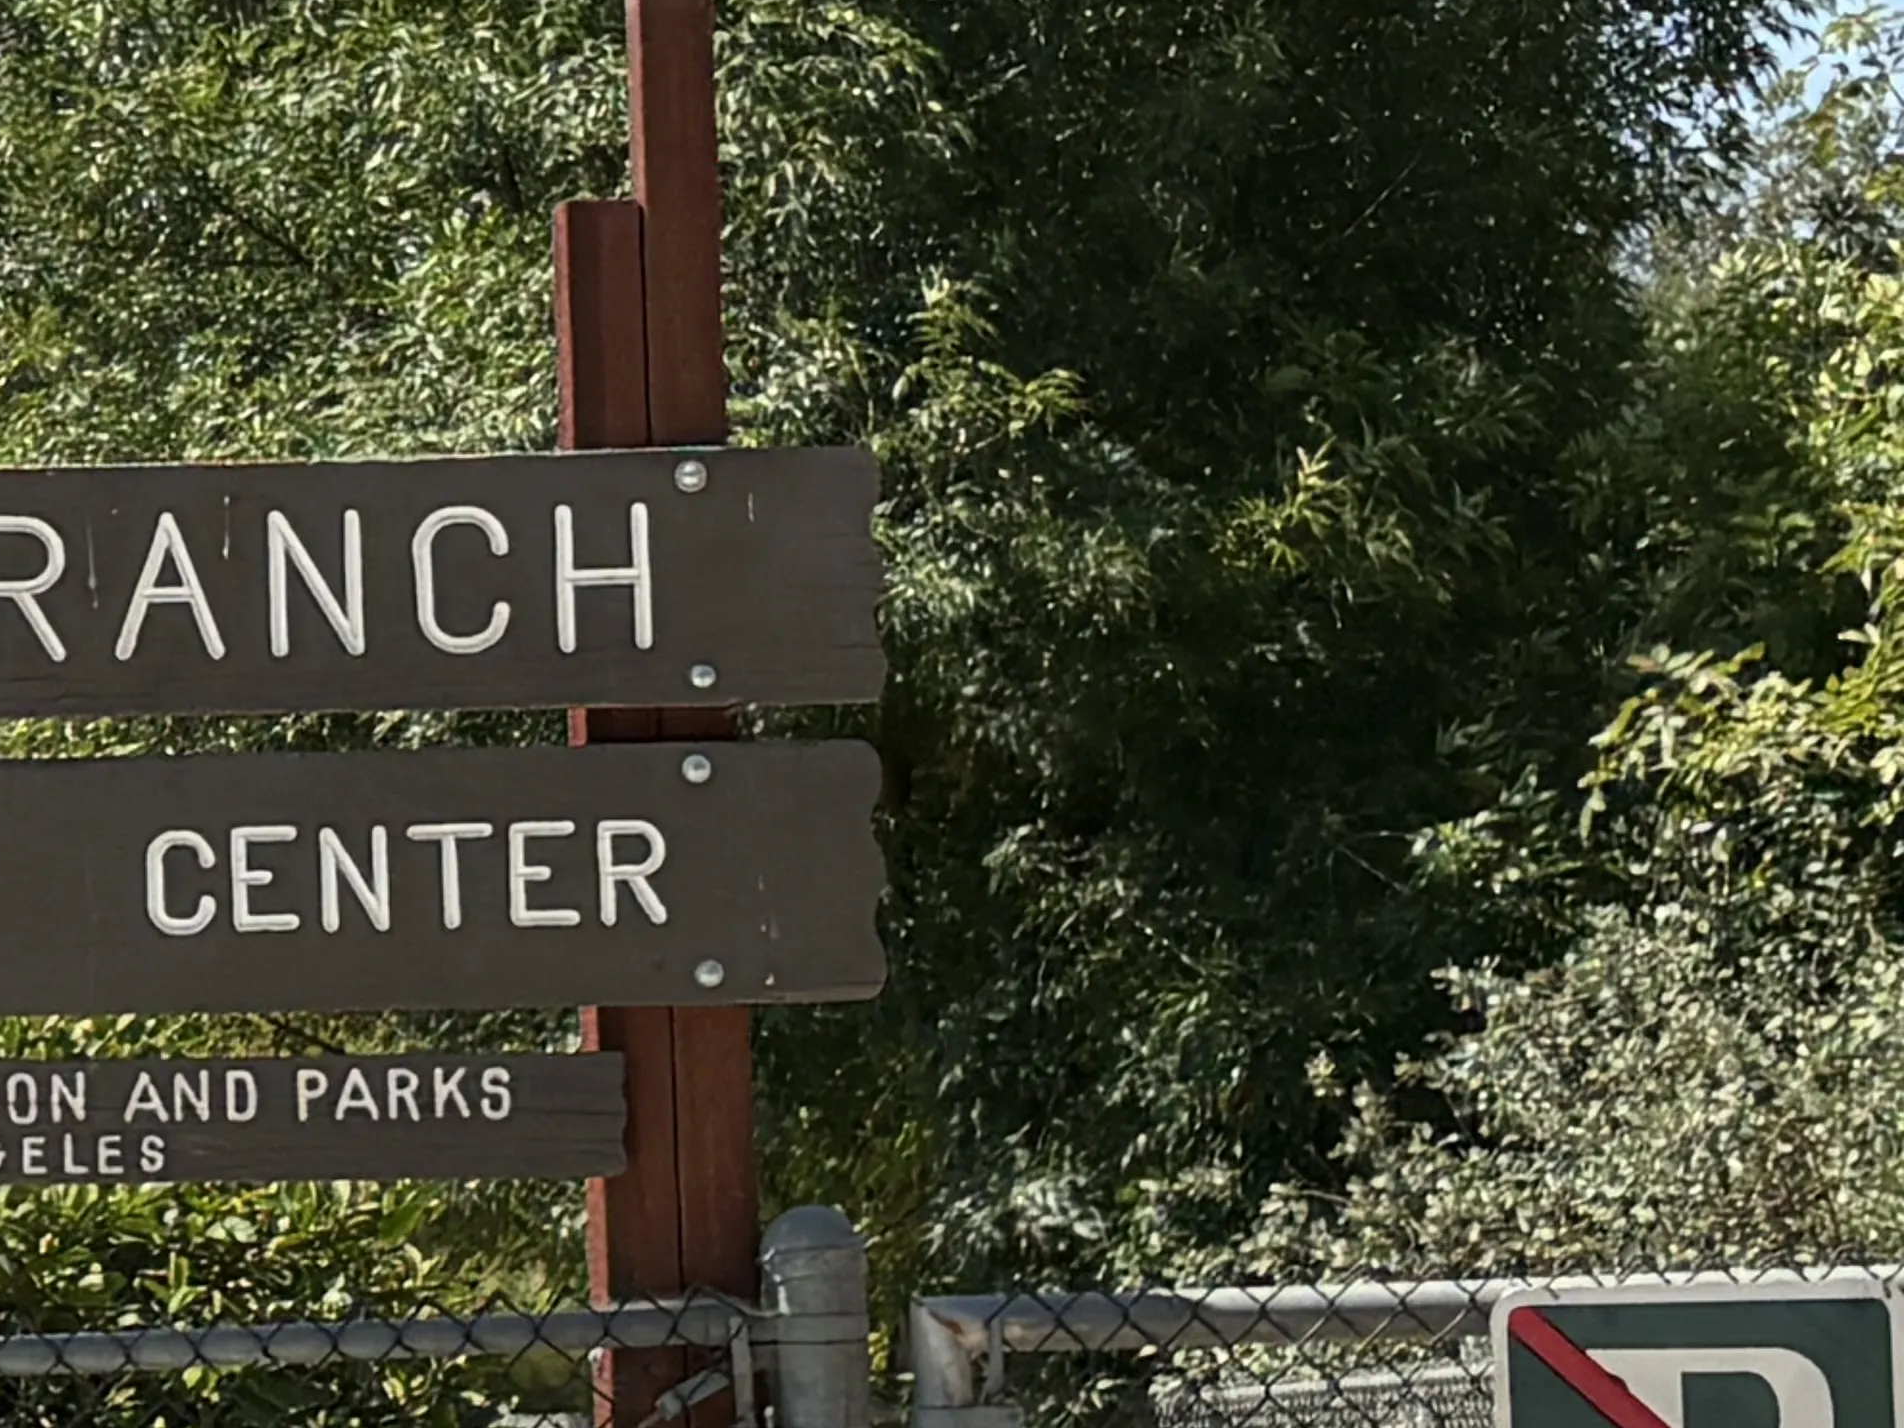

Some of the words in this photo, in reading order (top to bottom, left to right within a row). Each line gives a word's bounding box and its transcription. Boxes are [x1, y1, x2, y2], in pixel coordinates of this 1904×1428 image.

[145, 819, 668, 935] CENTER
[123, 1069, 259, 1123] AND
[295, 1066, 512, 1122] PARKS
